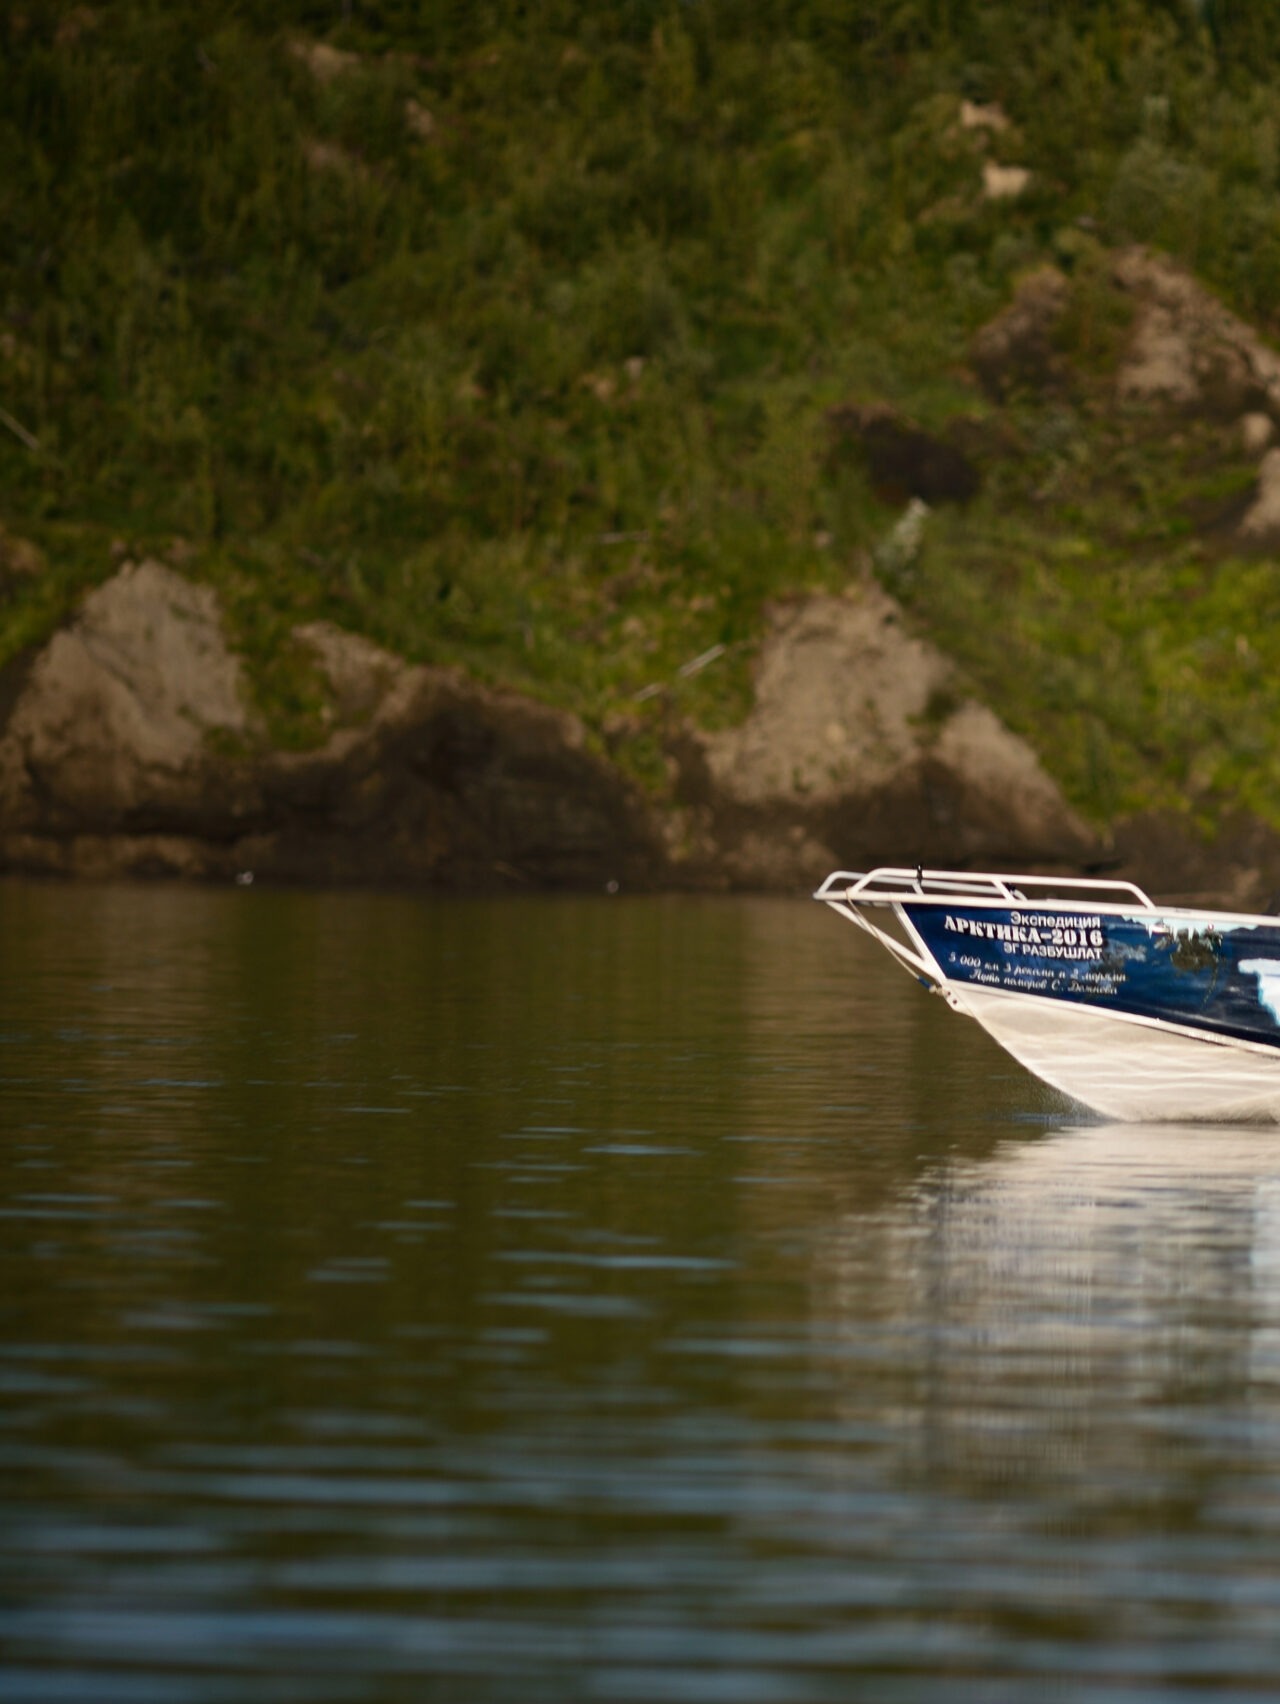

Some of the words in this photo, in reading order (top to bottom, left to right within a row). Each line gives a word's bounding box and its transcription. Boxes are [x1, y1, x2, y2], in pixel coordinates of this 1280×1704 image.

[1010, 911, 1100, 929] Экспедиция
[944, 915, 1103, 947] АРКТИКА-2016
[1022, 943, 1103, 960] РАЗБУШЛАТ
[960, 955, 981, 968] 000
[1003, 962, 1012, 973] 3
